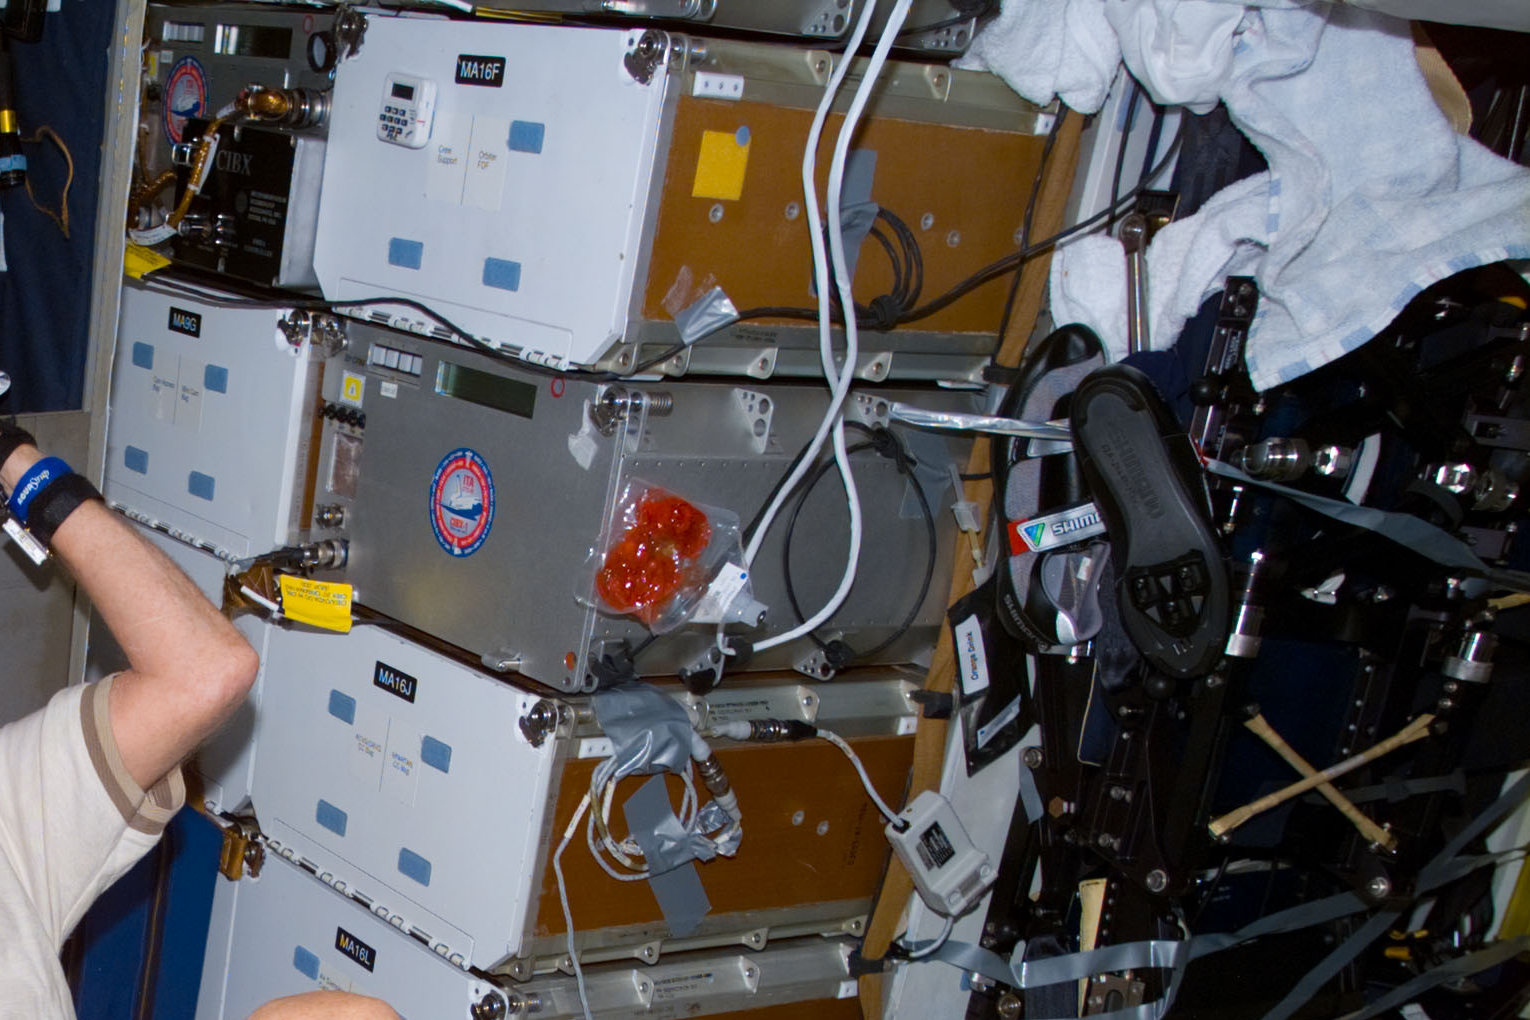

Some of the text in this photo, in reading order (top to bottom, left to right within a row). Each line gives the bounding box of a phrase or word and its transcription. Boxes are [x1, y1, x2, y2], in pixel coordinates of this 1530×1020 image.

[460, 61, 501, 80] MA16F
[216, 150, 254, 177] CIBX
[966, 630, 979, 681] Orange Drink
[378, 668, 412, 696] MA16J
[339, 933, 370, 966] MA16L
